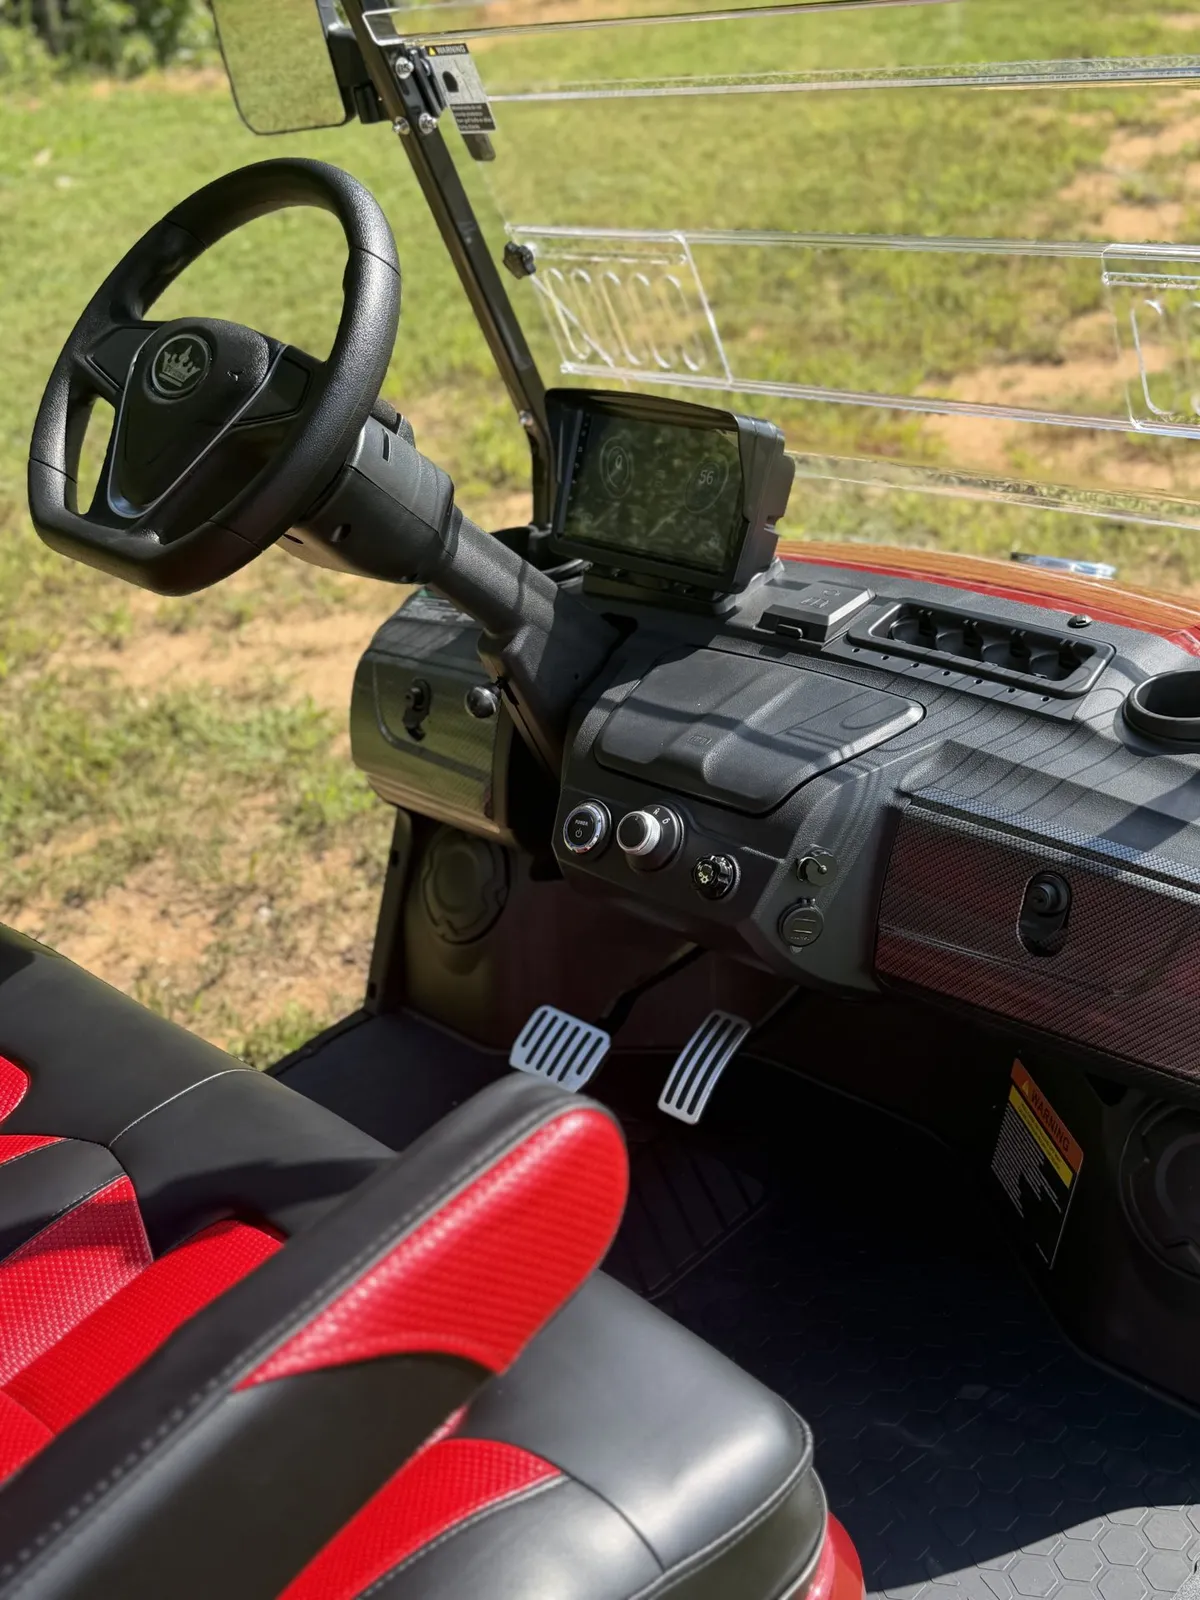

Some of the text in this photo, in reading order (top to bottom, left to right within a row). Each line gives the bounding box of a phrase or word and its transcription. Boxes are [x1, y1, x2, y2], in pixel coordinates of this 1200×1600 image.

[437, 45, 466, 54] WARNING
[699, 470, 714, 484] 56
[1031, 1090, 1070, 1152] WARNING
